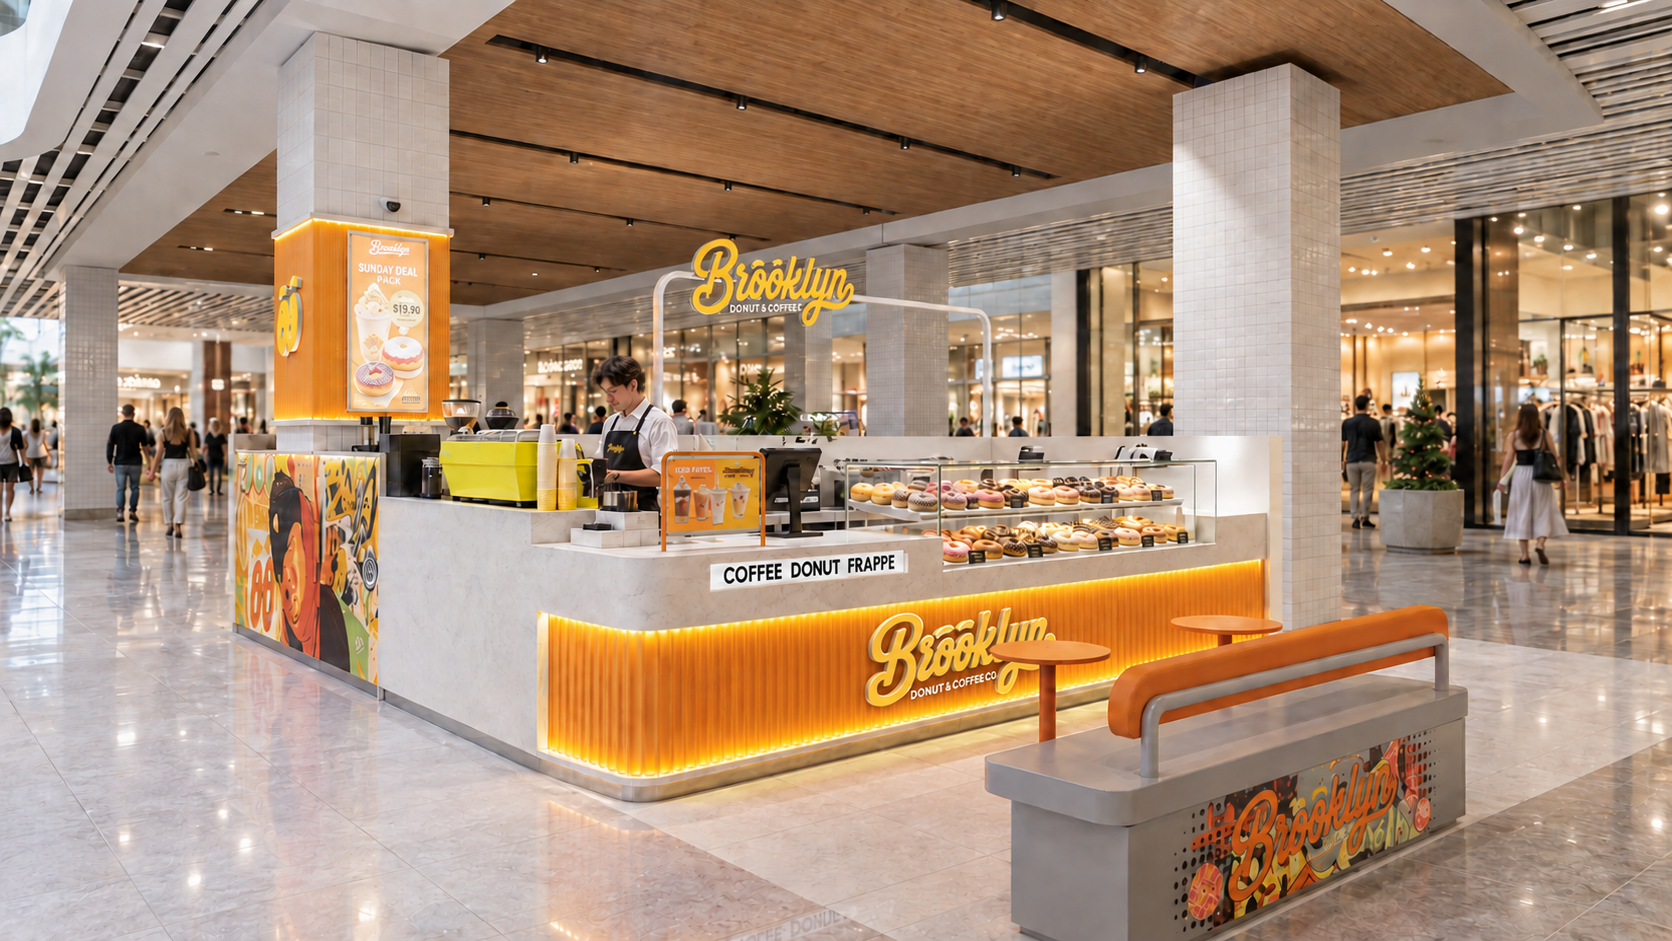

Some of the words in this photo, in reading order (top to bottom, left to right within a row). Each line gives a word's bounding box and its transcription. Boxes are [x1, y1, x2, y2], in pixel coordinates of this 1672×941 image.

[358, 262, 394, 275] SUNDAY
[395, 265, 418, 277] DEAL
[377, 275, 401, 285] PACK
[393, 303, 421, 315] $19.90
[729, 304, 760, 313] DONUT
[723, 562, 782, 584] COFFEE
[791, 559, 840, 579] DONUT
[848, 554, 895, 574] FRAPPE
[910, 682, 944, 700] DONUT
[945, 681, 951, 692] &
[952, 673, 985, 689] COFFEE
